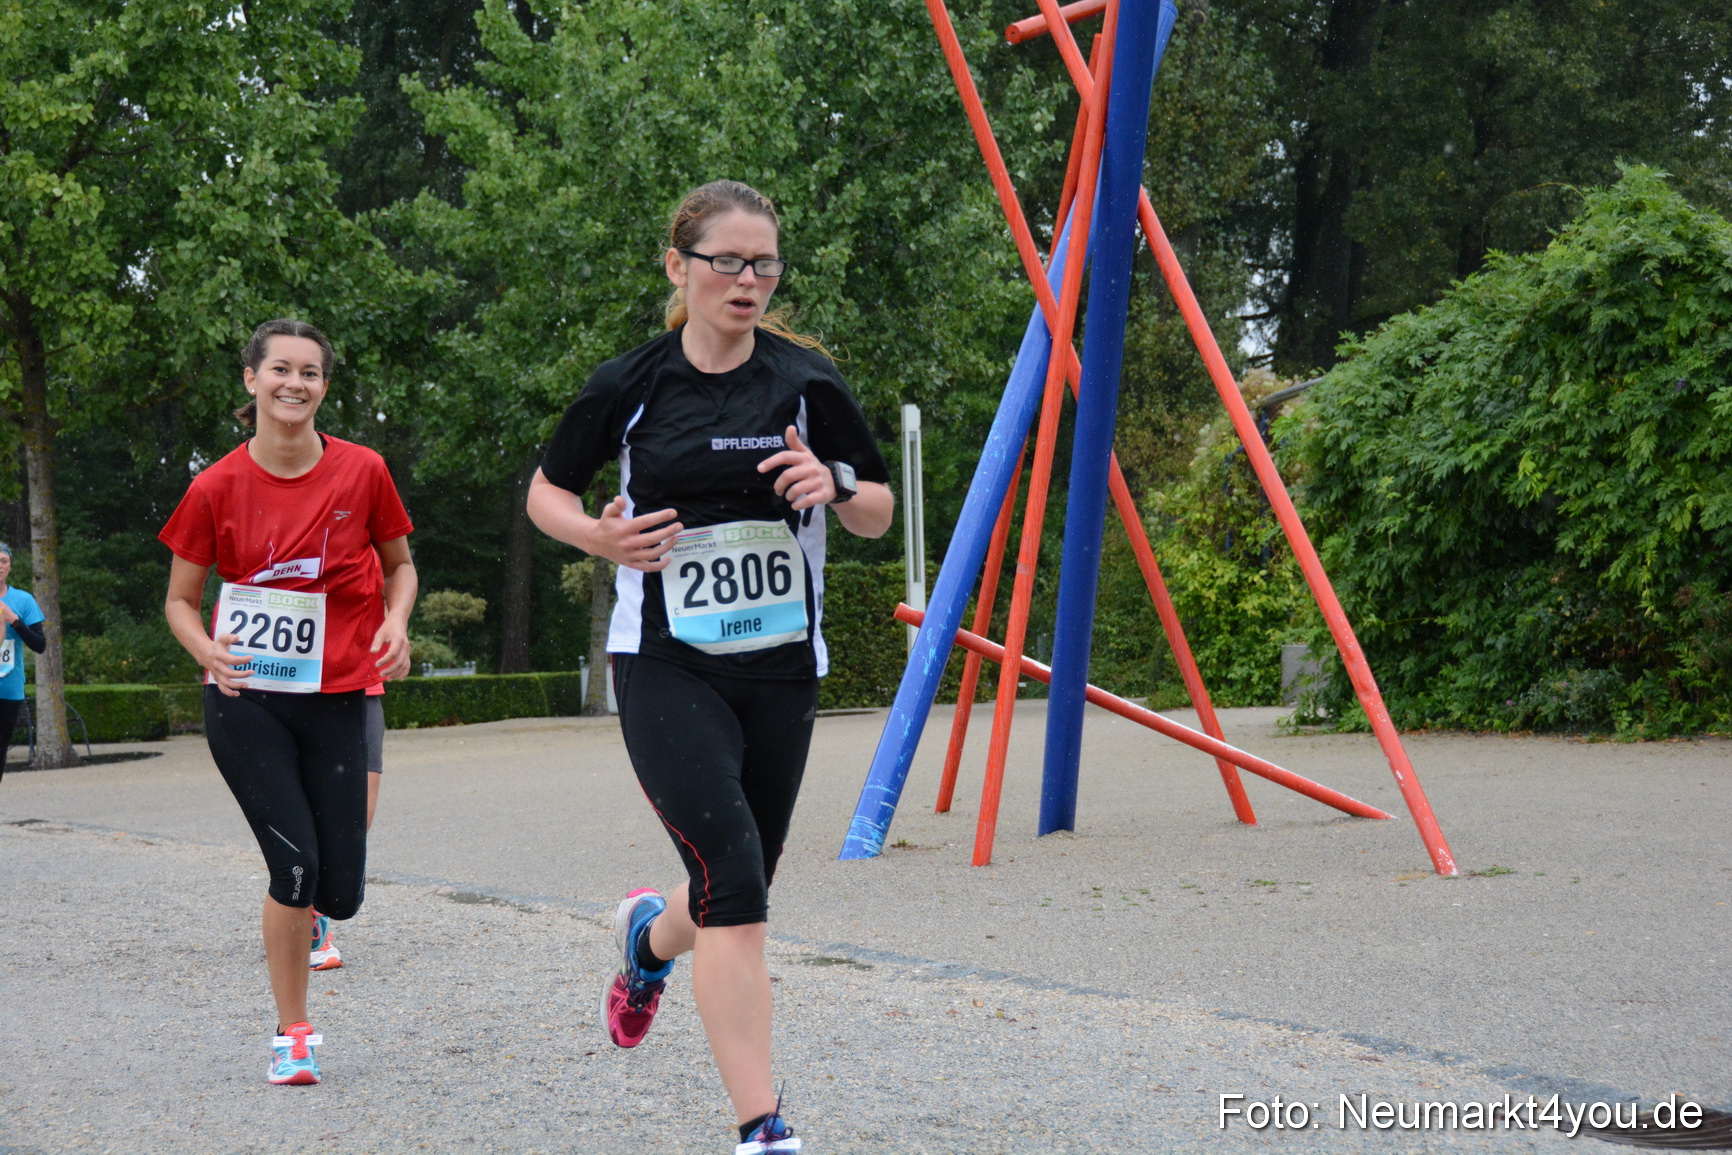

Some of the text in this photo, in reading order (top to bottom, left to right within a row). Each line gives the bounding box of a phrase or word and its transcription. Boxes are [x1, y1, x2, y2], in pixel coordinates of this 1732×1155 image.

[723, 525, 790, 544] BOCK
[671, 541, 717, 553] NeuerMarkt
[273, 565, 301, 577] DEHN
[679, 550, 792, 609] 2806
[229, 595, 262, 605] NeuerMarkt
[268, 592, 318, 609] BOCK
[229, 609, 316, 655] 2269
[720, 617, 762, 637] Irene
